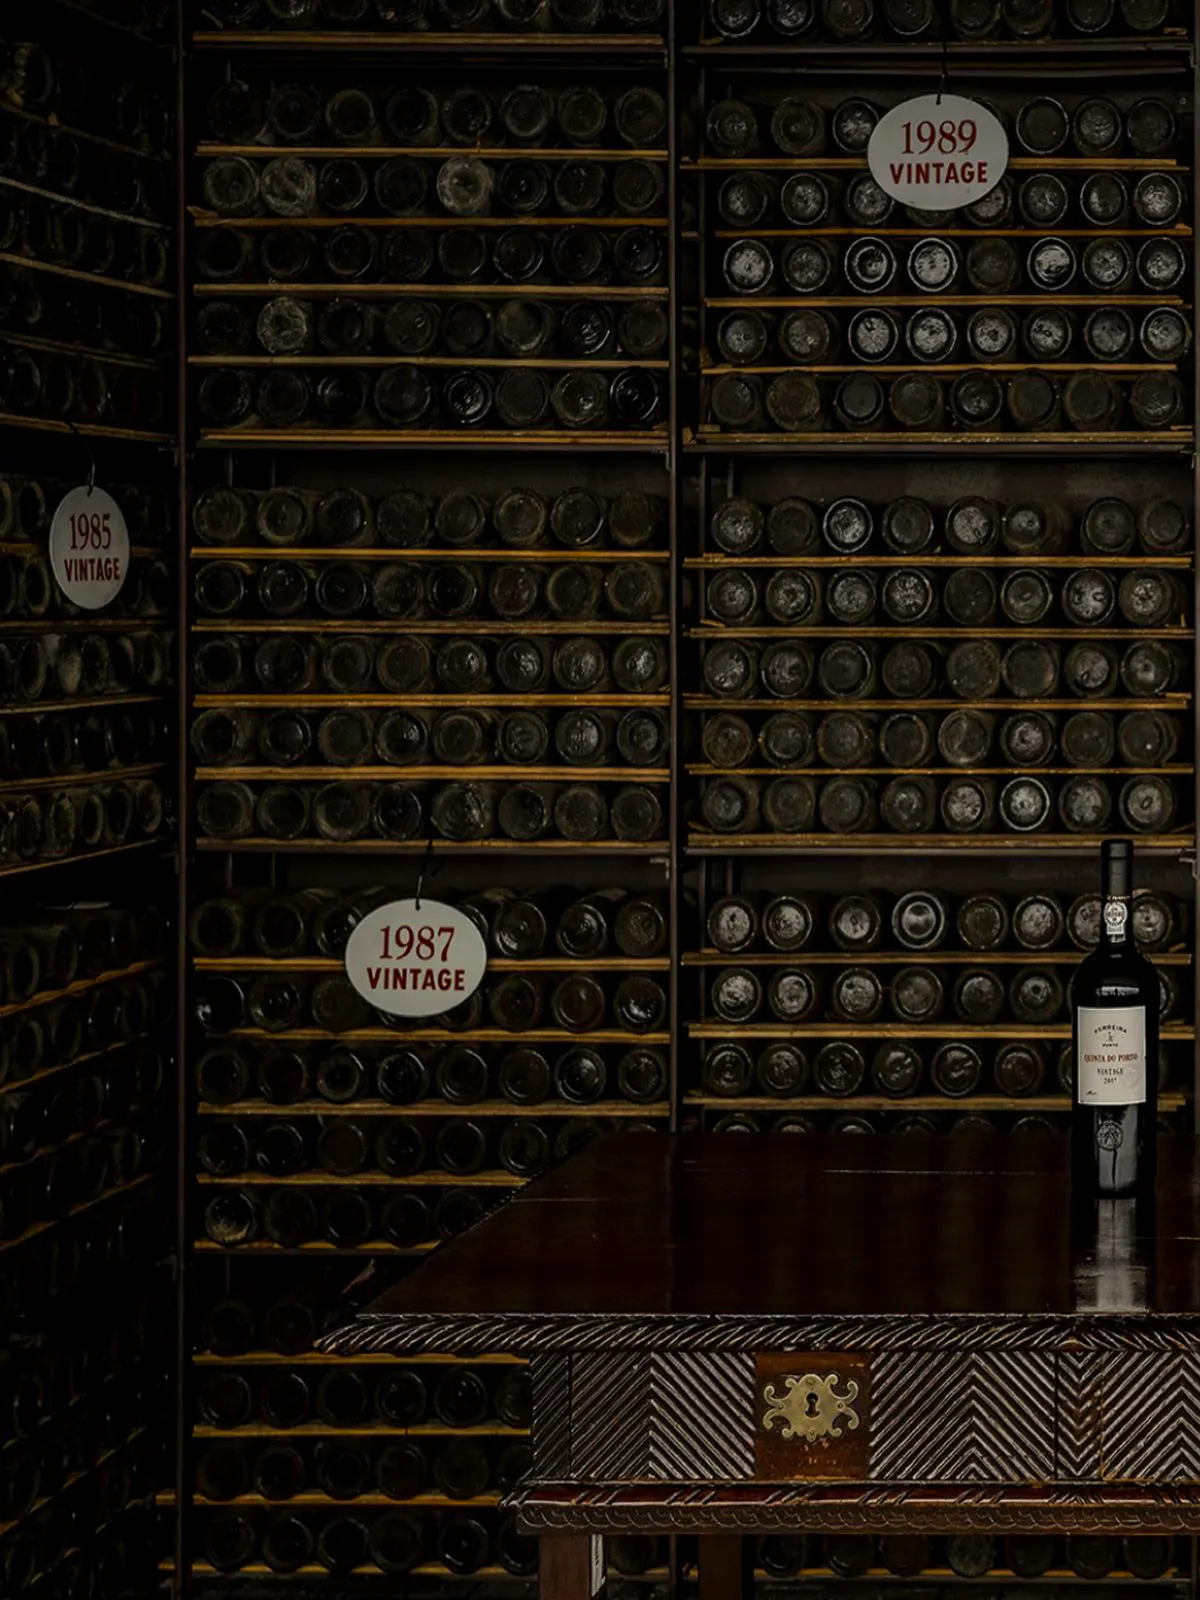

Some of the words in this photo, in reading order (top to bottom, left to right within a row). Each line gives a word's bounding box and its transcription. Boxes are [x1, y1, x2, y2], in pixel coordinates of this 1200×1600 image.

[901, 119, 977, 155] 1989
[889, 161, 988, 185] VINTAGE
[69, 511, 111, 550] 1985
[63, 557, 120, 583] VINTAGE
[379, 925, 455, 962] 1987
[366, 967, 466, 991] VINTAGE
[1084, 1054, 1105, 1063] QUINTA
[1107, 1054, 1117, 1062] DO
[1118, 1053, 1138, 1062] PORTO
[1097, 1068, 1124, 1076] VINTAGE
